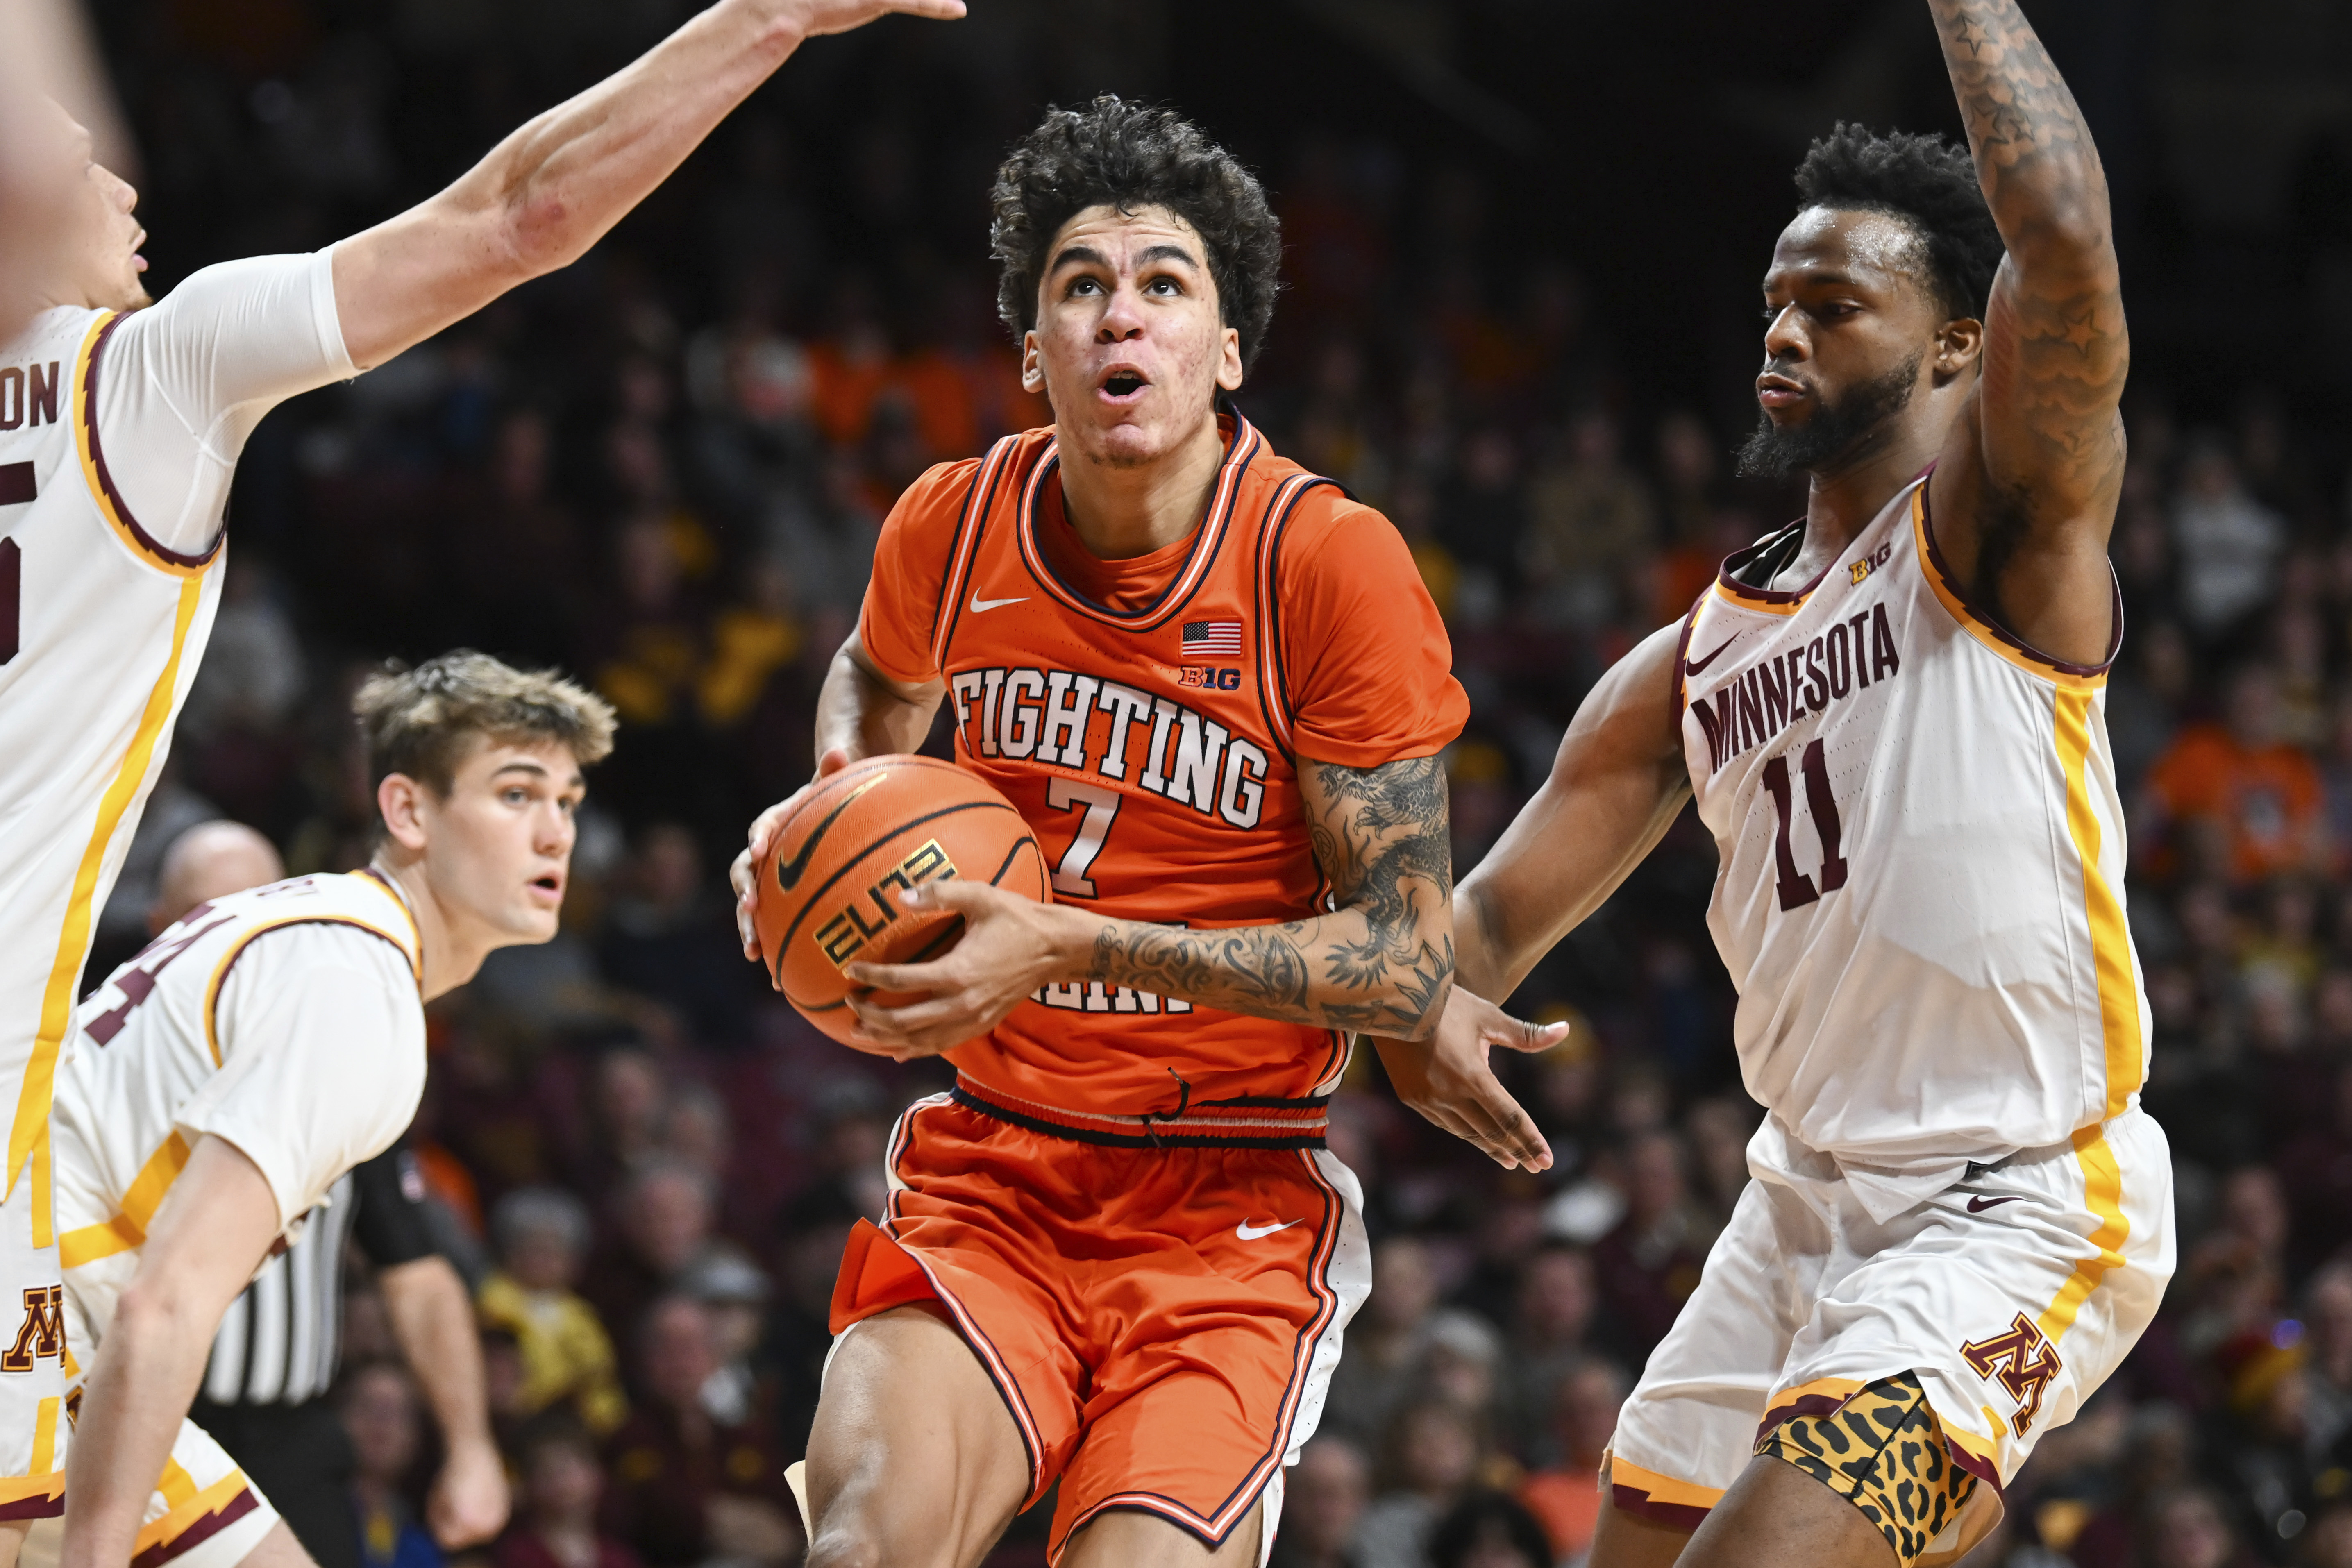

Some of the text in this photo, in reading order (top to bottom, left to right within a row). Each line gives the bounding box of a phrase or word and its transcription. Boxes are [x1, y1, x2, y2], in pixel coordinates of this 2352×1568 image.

[951, 667, 1269, 831] FIGHTING
[1690, 602, 1899, 774] MINNESOTA
[1046, 776, 1123, 900] 7
[1762, 737, 1847, 912] 11
